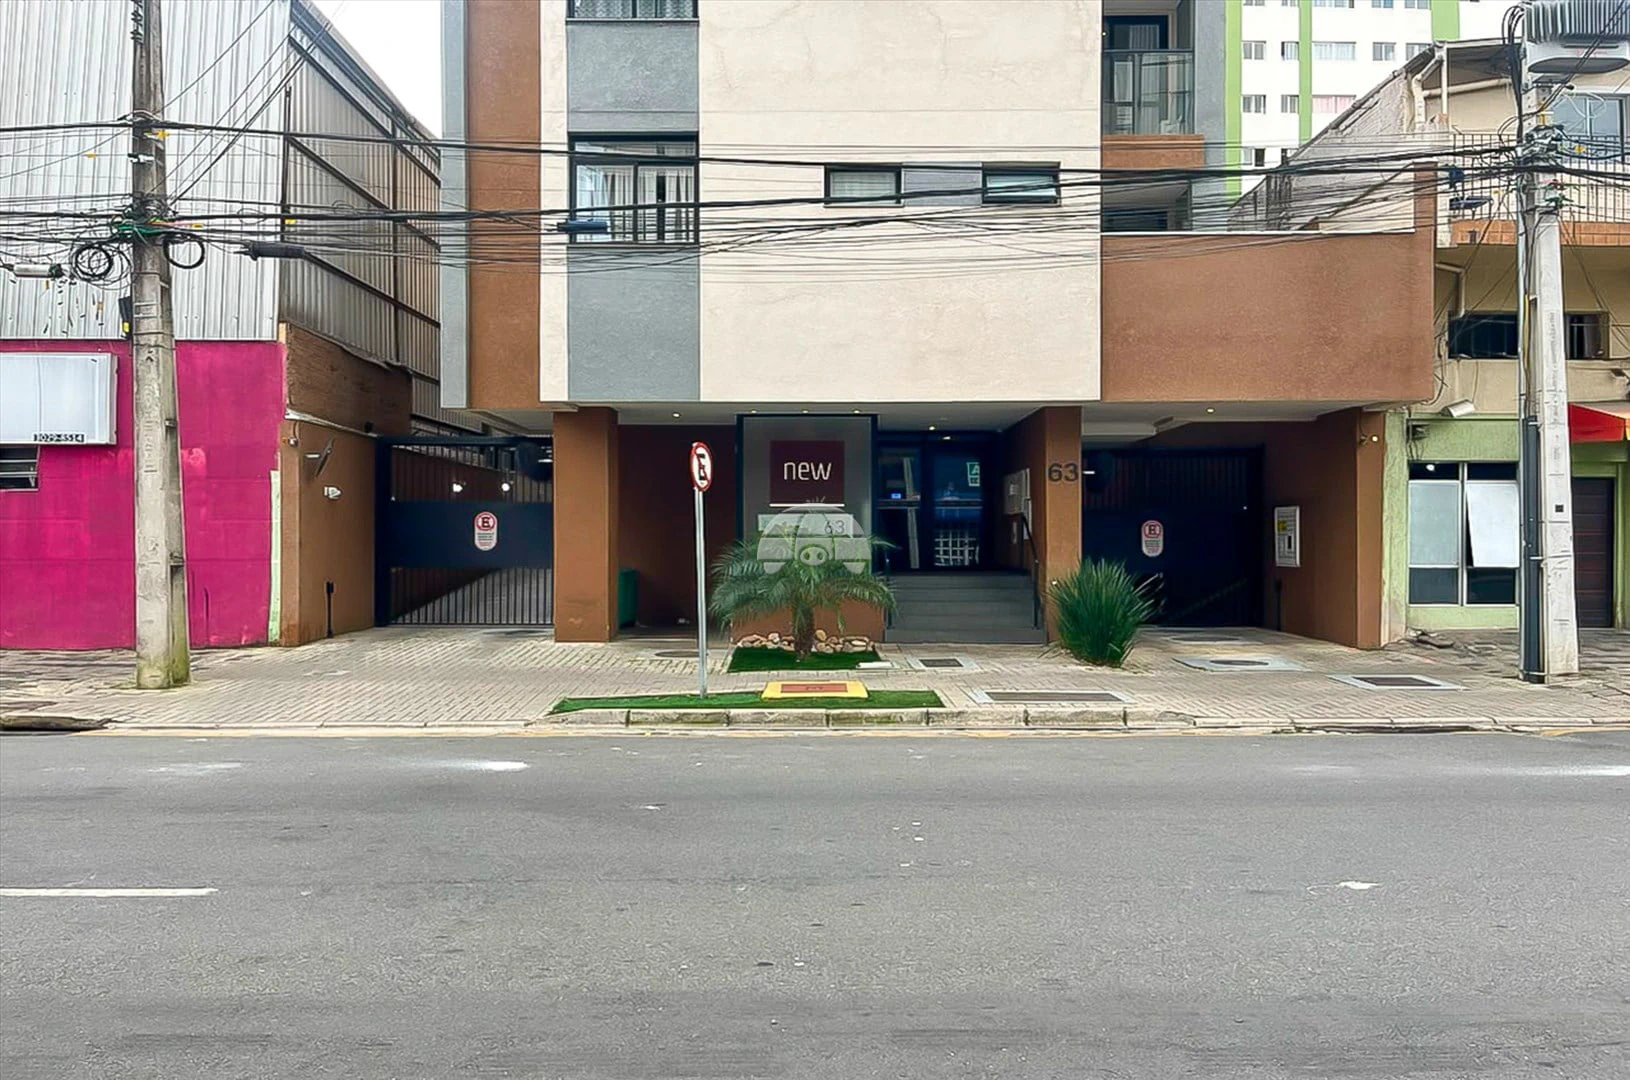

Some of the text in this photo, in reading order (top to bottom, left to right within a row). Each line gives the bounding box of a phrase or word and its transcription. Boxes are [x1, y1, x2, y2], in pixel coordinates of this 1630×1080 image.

[783, 462, 832, 480] new
[1048, 463, 1079, 482] 63
[824, 520, 845, 534] 63
